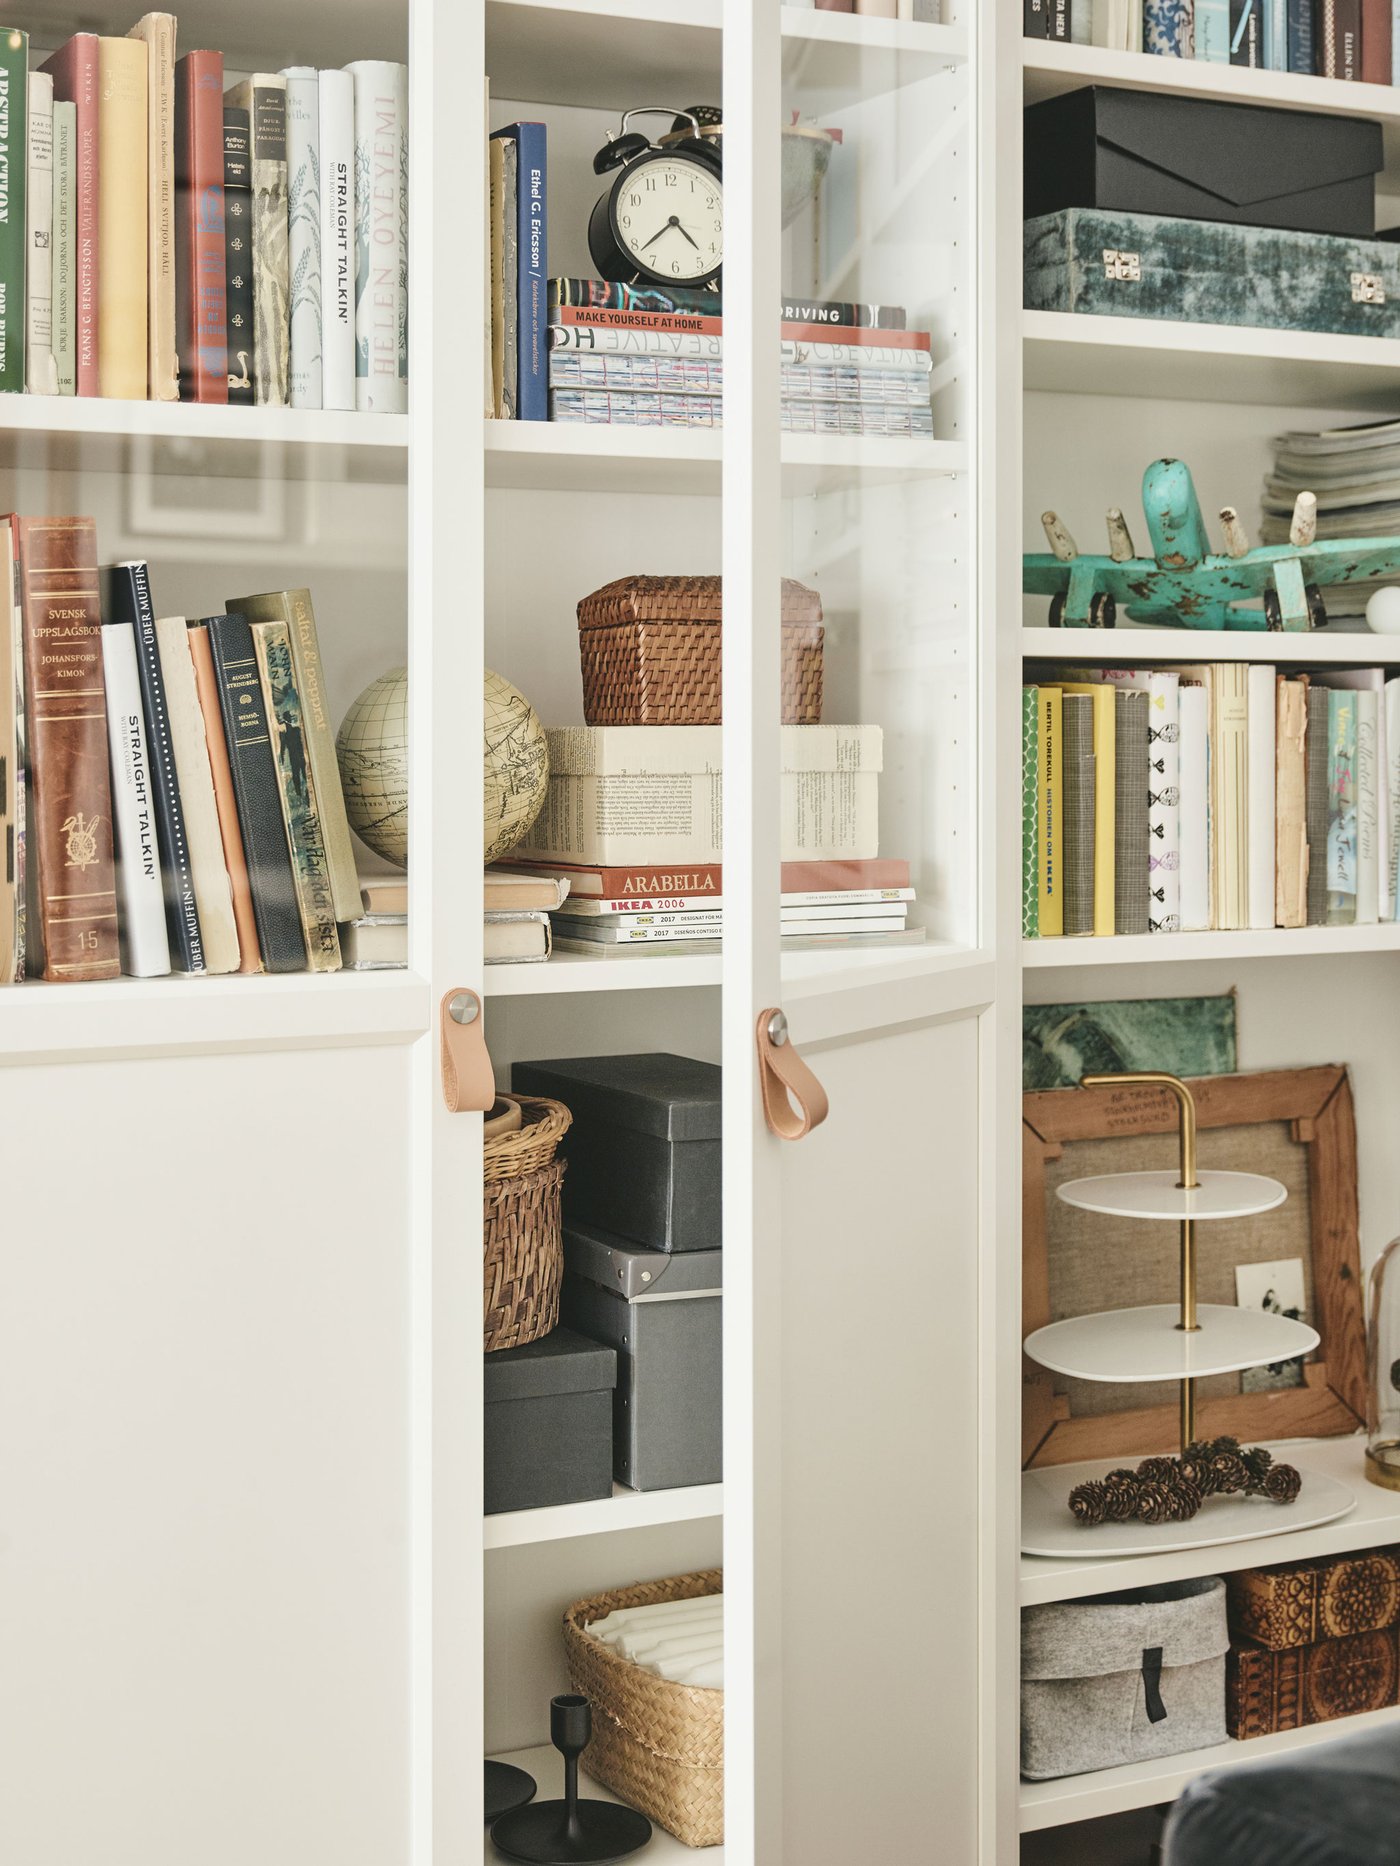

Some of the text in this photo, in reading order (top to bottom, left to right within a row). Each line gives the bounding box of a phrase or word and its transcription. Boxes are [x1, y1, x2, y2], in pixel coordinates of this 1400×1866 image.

[1056, 13, 1065, 36] HEM
[531, 169, 541, 198] Ethel
[646, 179, 656, 191] 11
[665, 174, 677, 186] 12
[690, 180, 694, 193] 1
[338, 163, 347, 250] STRAIGHT
[630, 194, 641, 206] 10
[706, 197, 714, 209] 2
[531, 202, 540, 215] G.
[623, 216, 631, 228] 9
[714, 220, 722, 232] 3
[373, 97, 396, 377] HELEN OYEYEMI
[532, 219, 541, 267] Ericsson
[630, 239, 639, 251] 8
[709, 242, 716, 253] 4
[649, 255, 656, 267] 7
[672, 261, 680, 273] 6
[696, 257, 704, 269] 5
[82, 239, 92, 310] BENGTSSON
[82, 313, 92, 324] G.
[576, 311, 703, 330] MAKE YOURSELF AT HOME
[781, 306, 840, 322] RIVING
[82, 325, 92, 366] FRANS
[606, 329, 720, 354] REATIVE
[135, 564, 155, 645] ÜBER MUFFIN
[48, 609, 87, 620] SVENSK
[32, 626, 101, 638] UPPSLAGSBOK
[41, 654, 98, 665] JOHANSFORS-
[57, 670, 85, 678] KIMON
[129, 715, 147, 806] STRAIGHT
[1047, 841, 1052, 856] OM
[622, 873, 716, 894] ARABELLA
[611, 899, 685, 911] IKEA 2006
[183, 891, 203, 971] ÜBER MUFFIN
[78, 930, 98, 950] 15
